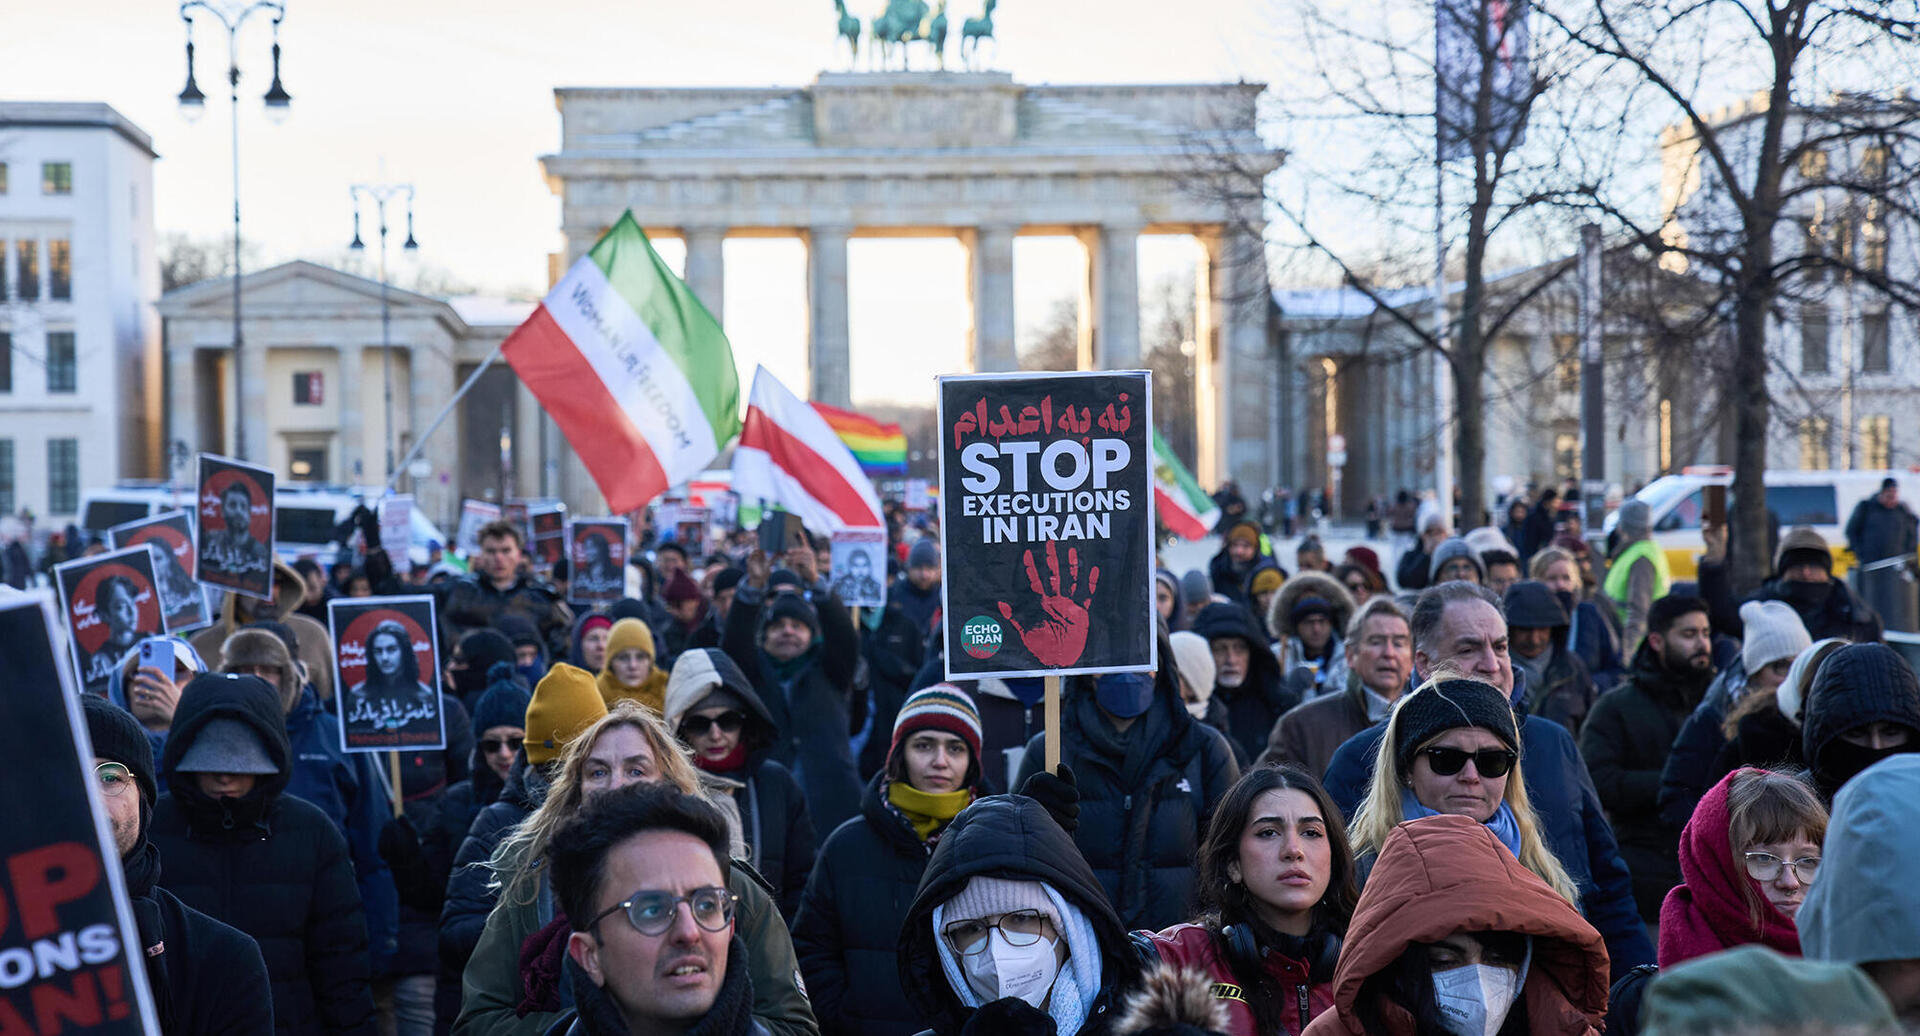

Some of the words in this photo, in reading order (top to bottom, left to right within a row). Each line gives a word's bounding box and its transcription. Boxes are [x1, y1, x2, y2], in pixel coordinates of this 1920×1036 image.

[954, 394, 1052, 449] اعدام
[1058, 403, 1091, 445] به
[1098, 393, 1131, 437] نه
[961, 438, 1131, 494] STOP
[963, 490, 1131, 516] EXECUTIONS
[983, 516, 1018, 543] IN
[1027, 512, 1111, 542] IRAN
[965, 624, 1000, 635] ECHO
[972, 634, 1002, 644] IRAN
[0, 841, 99, 940] P
